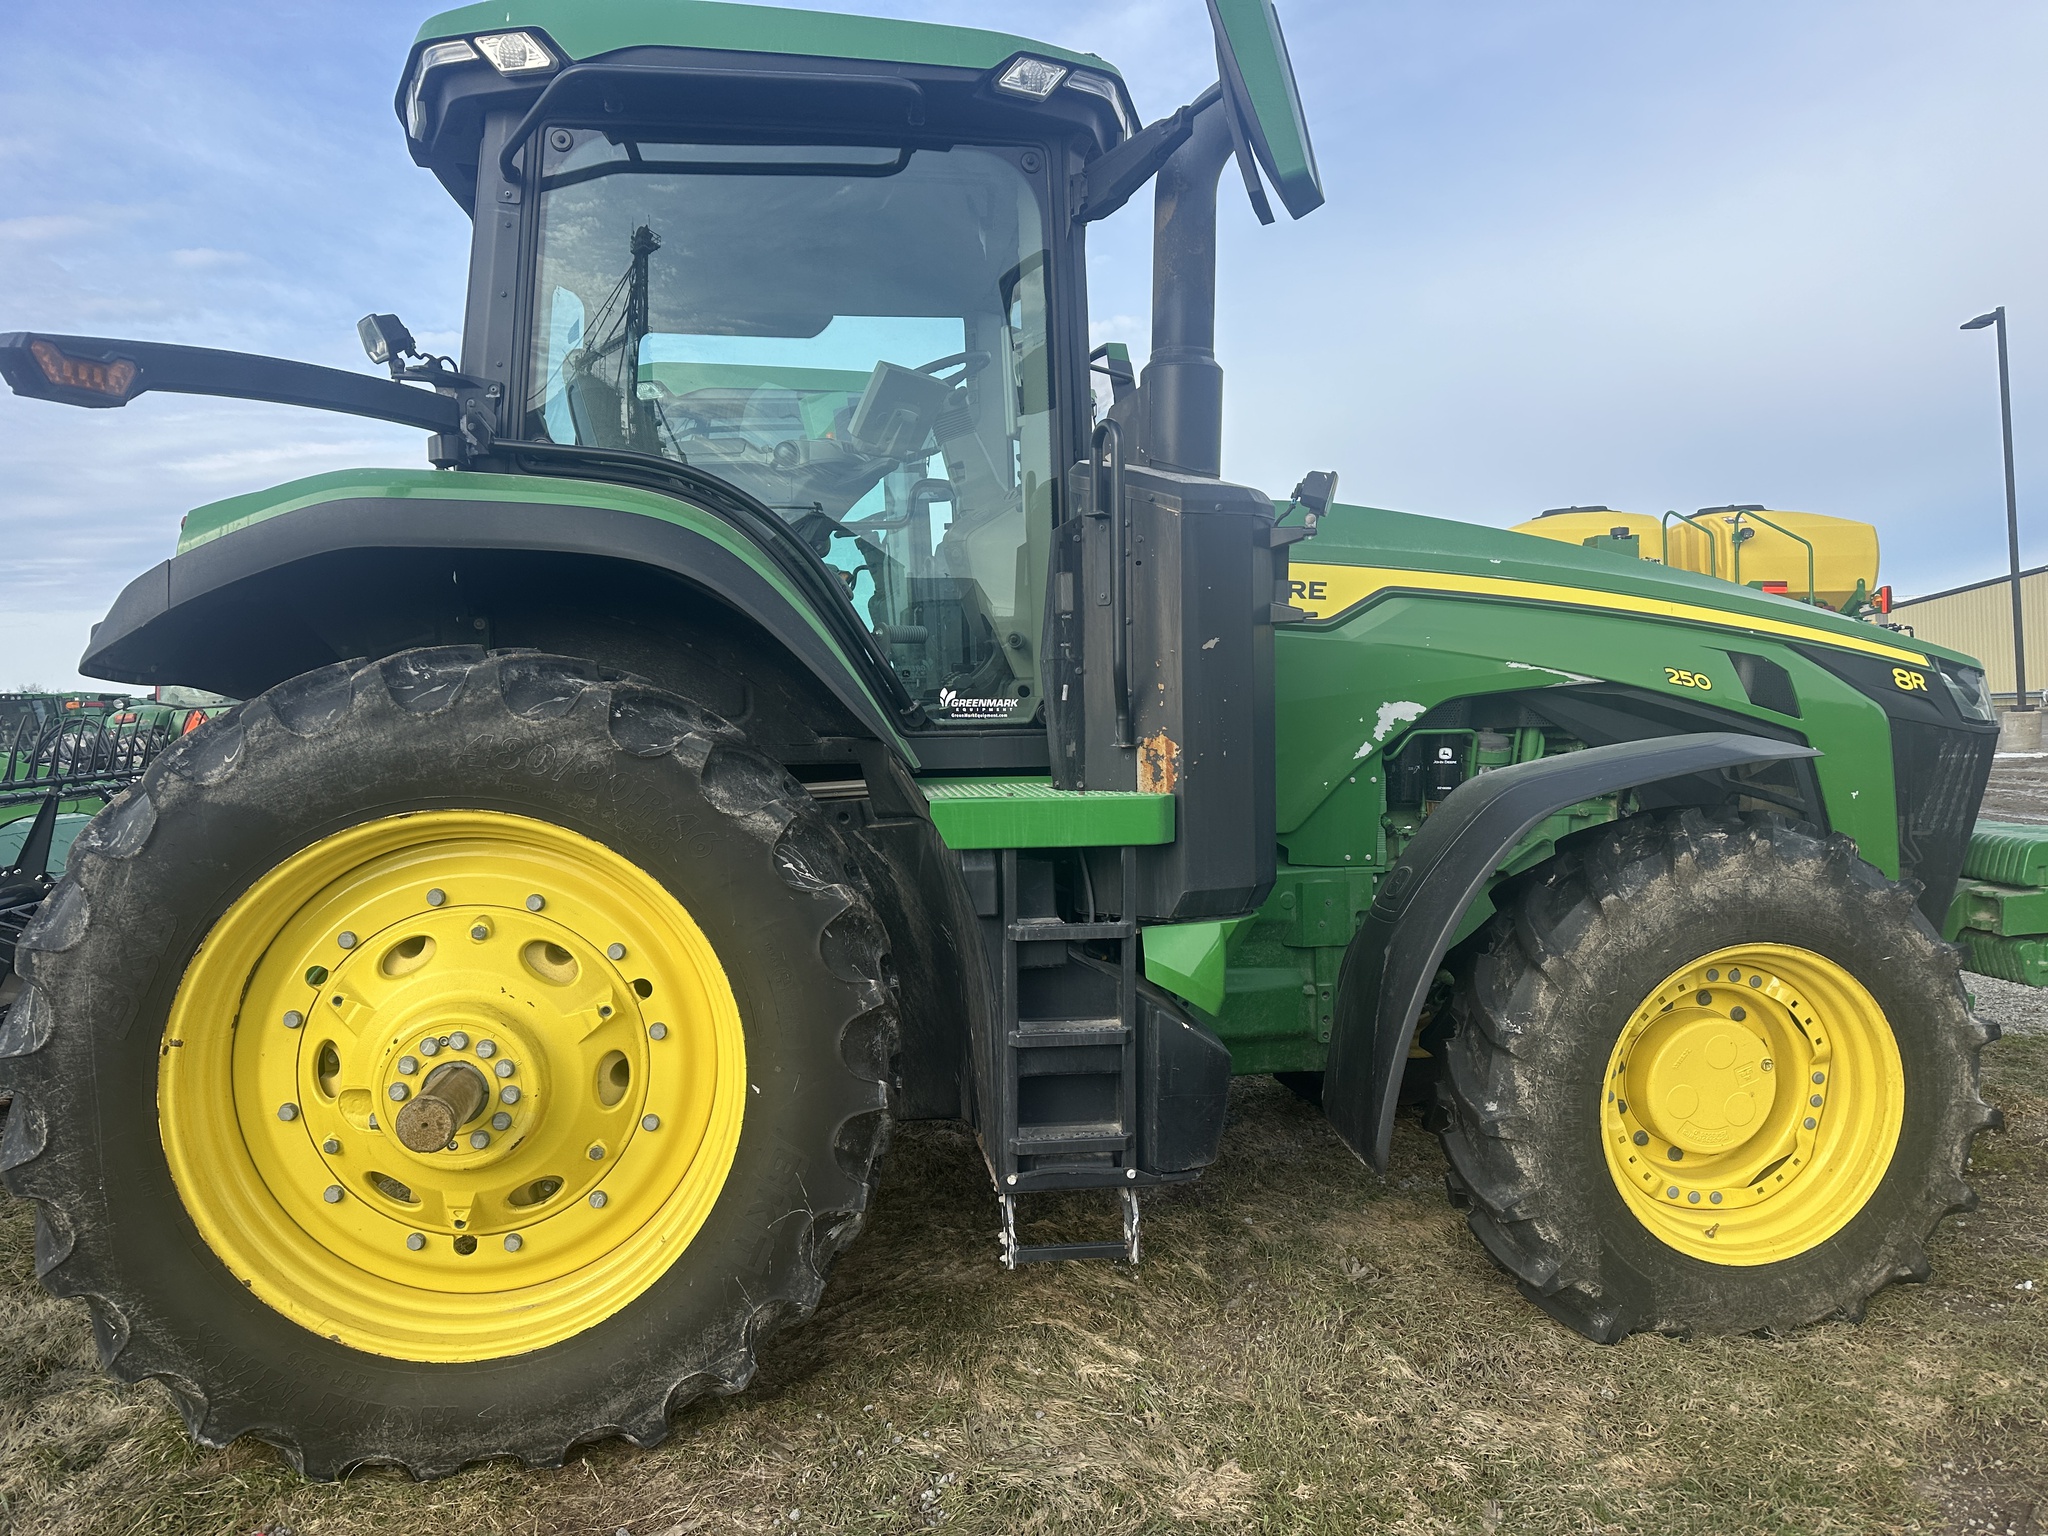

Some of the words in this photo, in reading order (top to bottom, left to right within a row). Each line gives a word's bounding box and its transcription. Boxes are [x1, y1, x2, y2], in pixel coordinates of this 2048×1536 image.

[1663, 666, 1712, 691] 250
[1892, 667, 1928, 692] 8R
[951, 698, 1019, 707] GREENMARK
